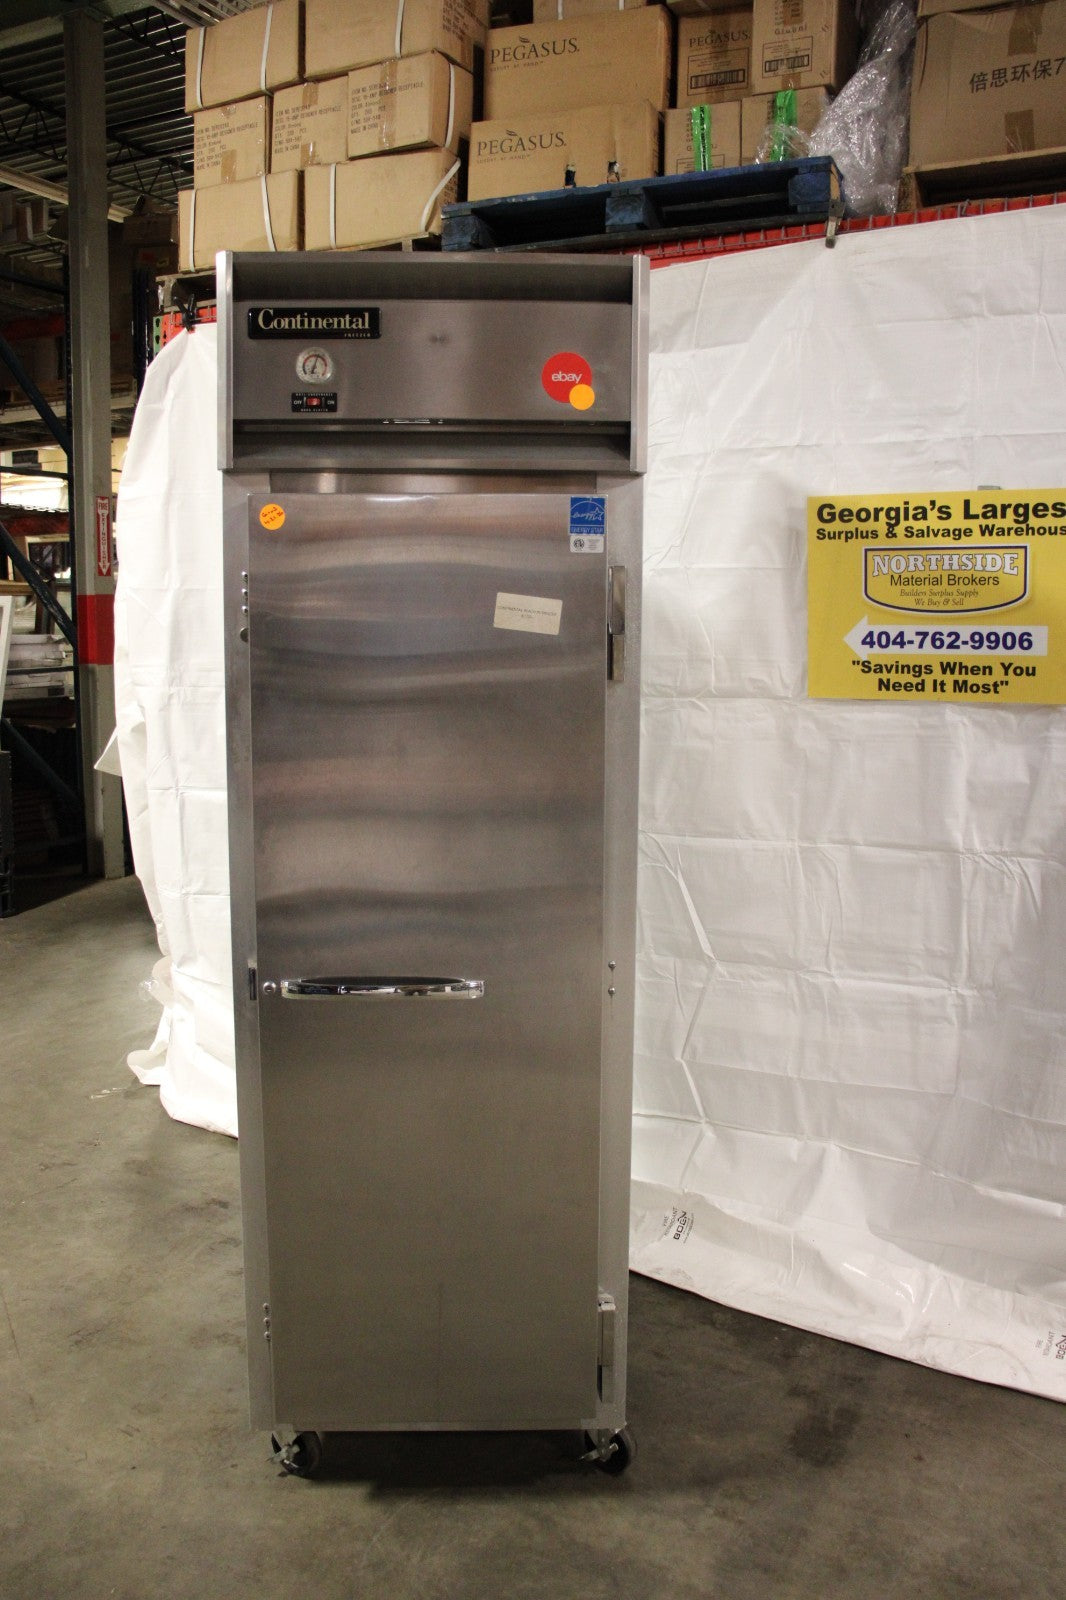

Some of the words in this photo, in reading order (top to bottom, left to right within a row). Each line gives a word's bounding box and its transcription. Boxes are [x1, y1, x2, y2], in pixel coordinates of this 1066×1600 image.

[689, 30, 751, 47] PEGASUS
[490, 38, 578, 64] PEGASUS
[477, 132, 565, 156] PEGASUS
[258, 308, 369, 330] Continental
[551, 371, 583, 384] ebay
[98, 502, 108, 511] FIRE
[817, 500, 952, 527] Georgia's
[964, 499, 1066, 524] Larges
[816, 527, 879, 543] Surplus
[885, 525, 898, 539] &
[904, 526, 973, 541] Salvage
[872, 553, 1018, 577] NORTHSIDE
[891, 574, 942, 586] Material
[947, 574, 999, 586] Brokers
[952, 598, 964, 606] Sell
[956, 588, 979, 598] Supply
[861, 630, 1033, 651] 404-762-9906
[852, 660, 933, 678] "Savings
[940, 661, 993, 676] When
[1000, 662, 1037, 677] You
[878, 678, 926, 693] Need
[932, 679, 946, 693] It
[953, 680, 1009, 694] Most"
